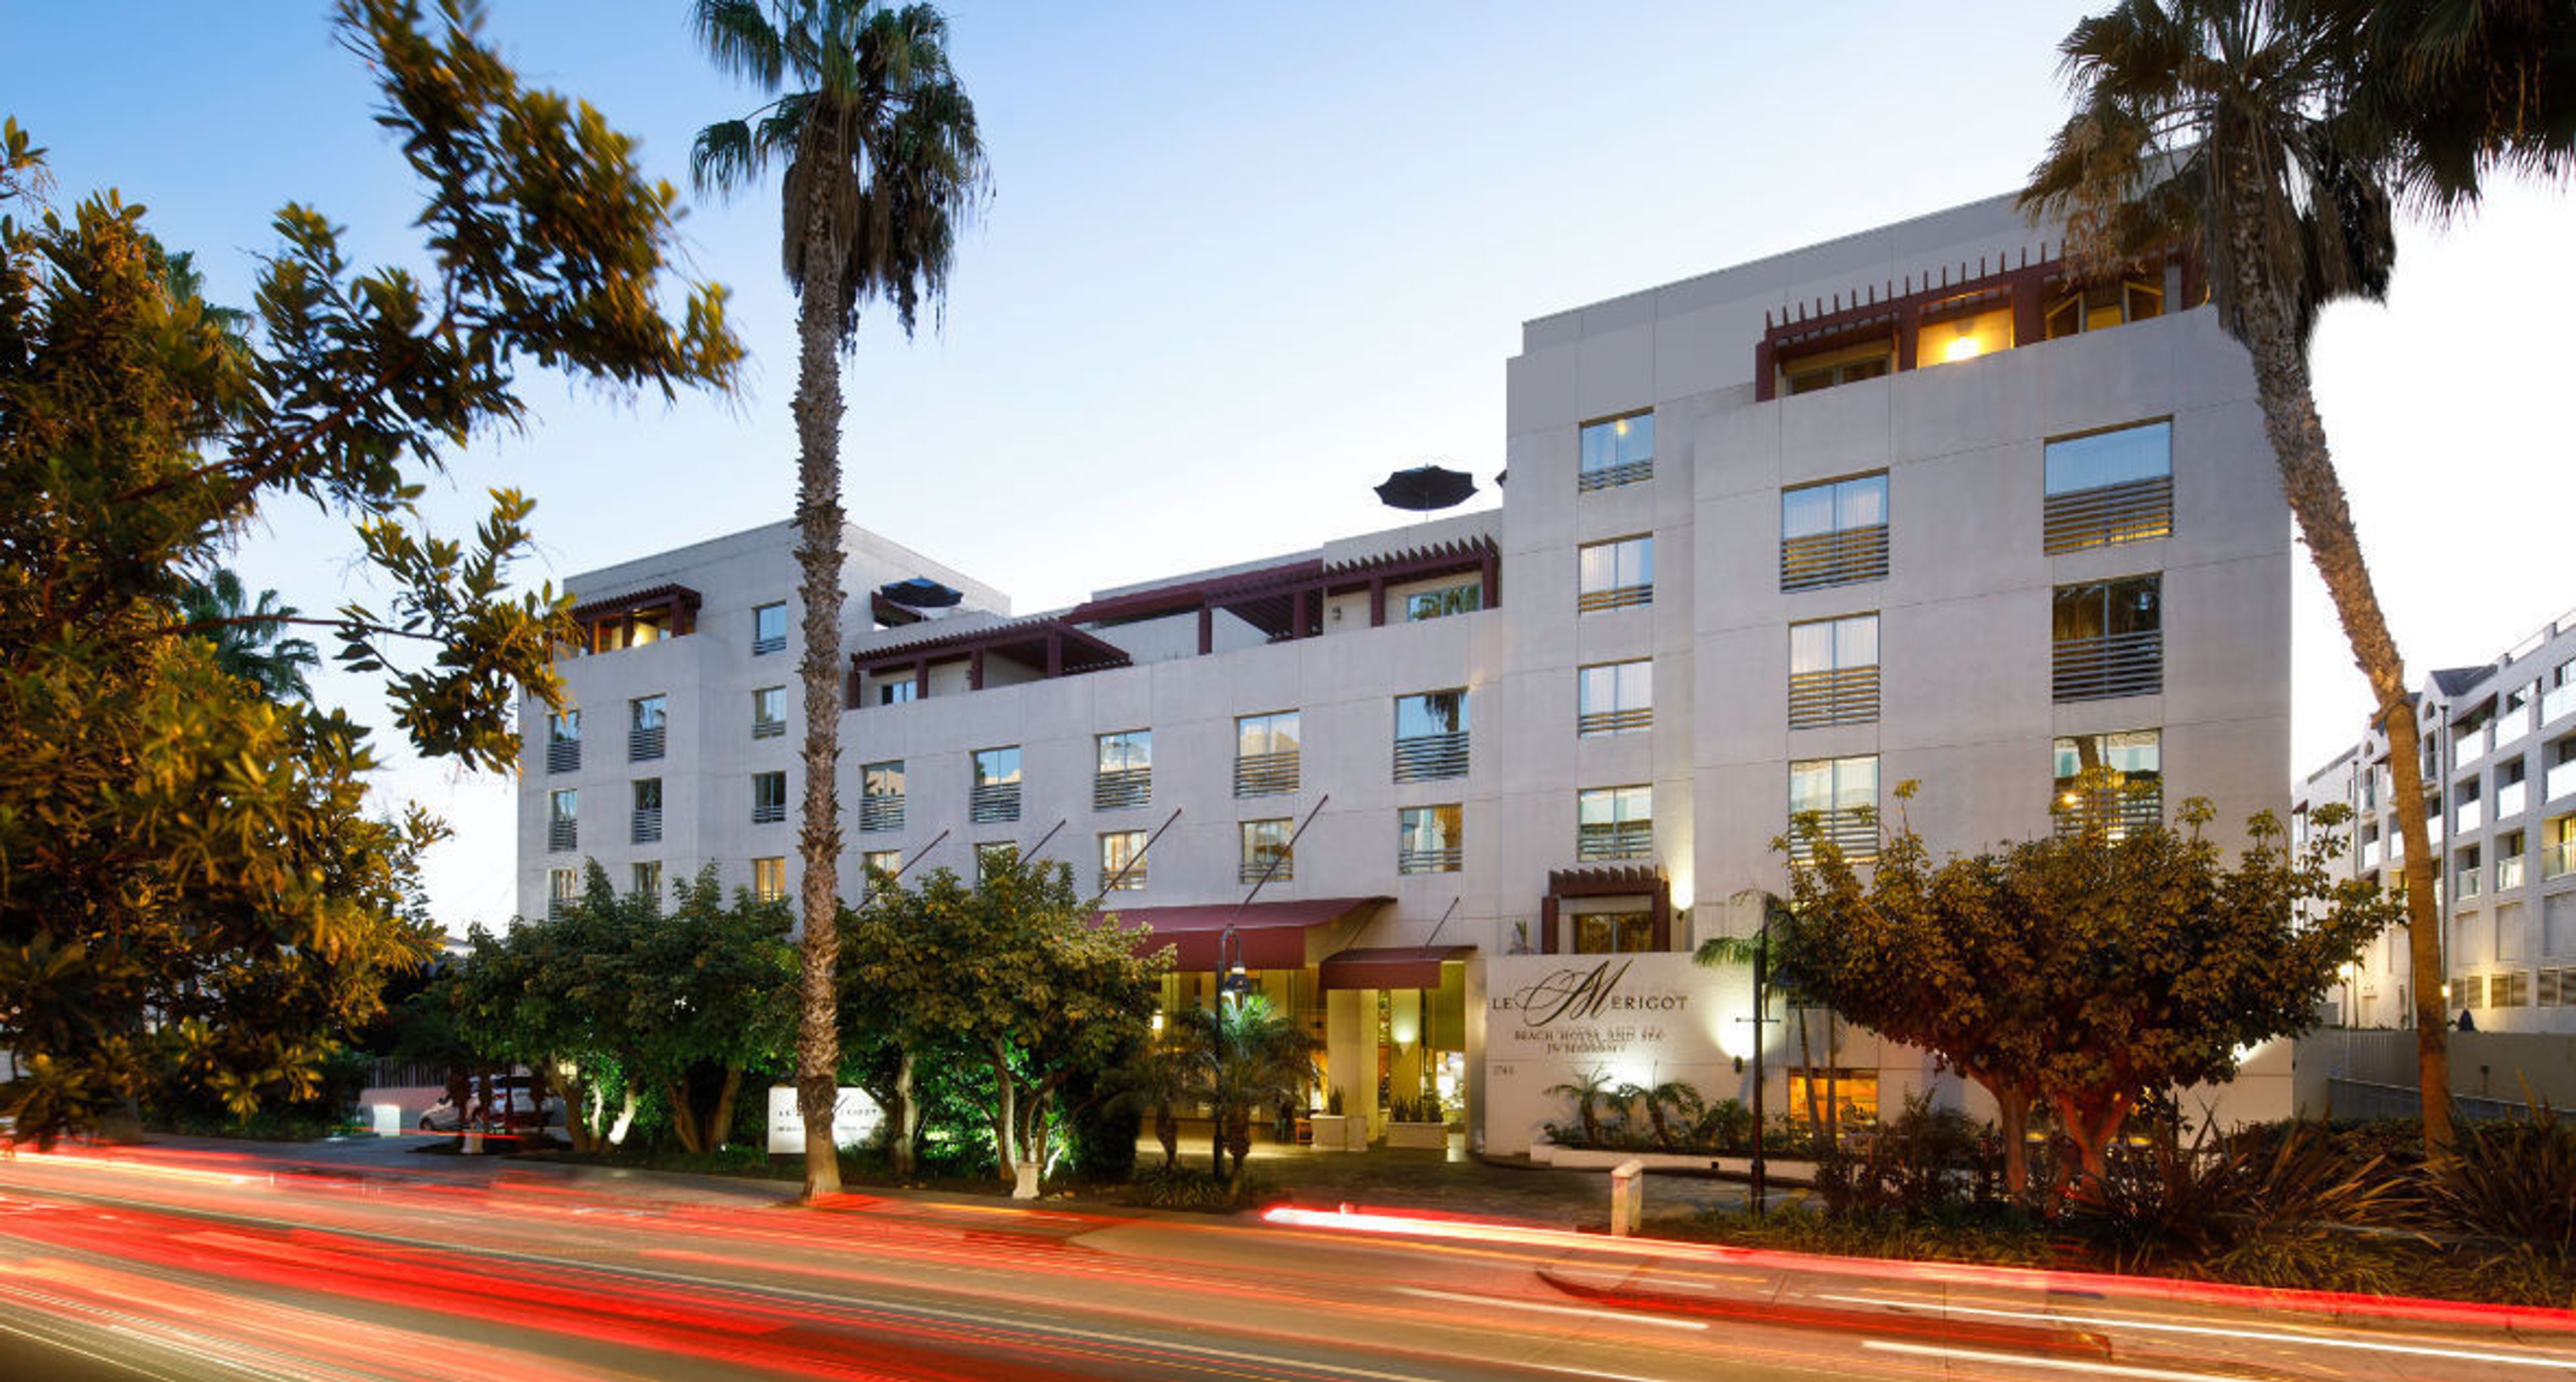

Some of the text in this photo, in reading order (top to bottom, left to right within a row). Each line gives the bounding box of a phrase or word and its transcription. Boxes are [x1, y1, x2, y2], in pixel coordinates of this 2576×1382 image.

[1492, 958, 1689, 1026] LE MERIGOT
[1514, 1030, 1553, 1041] BEACH
[1560, 1029, 1599, 1041] HOTEL
